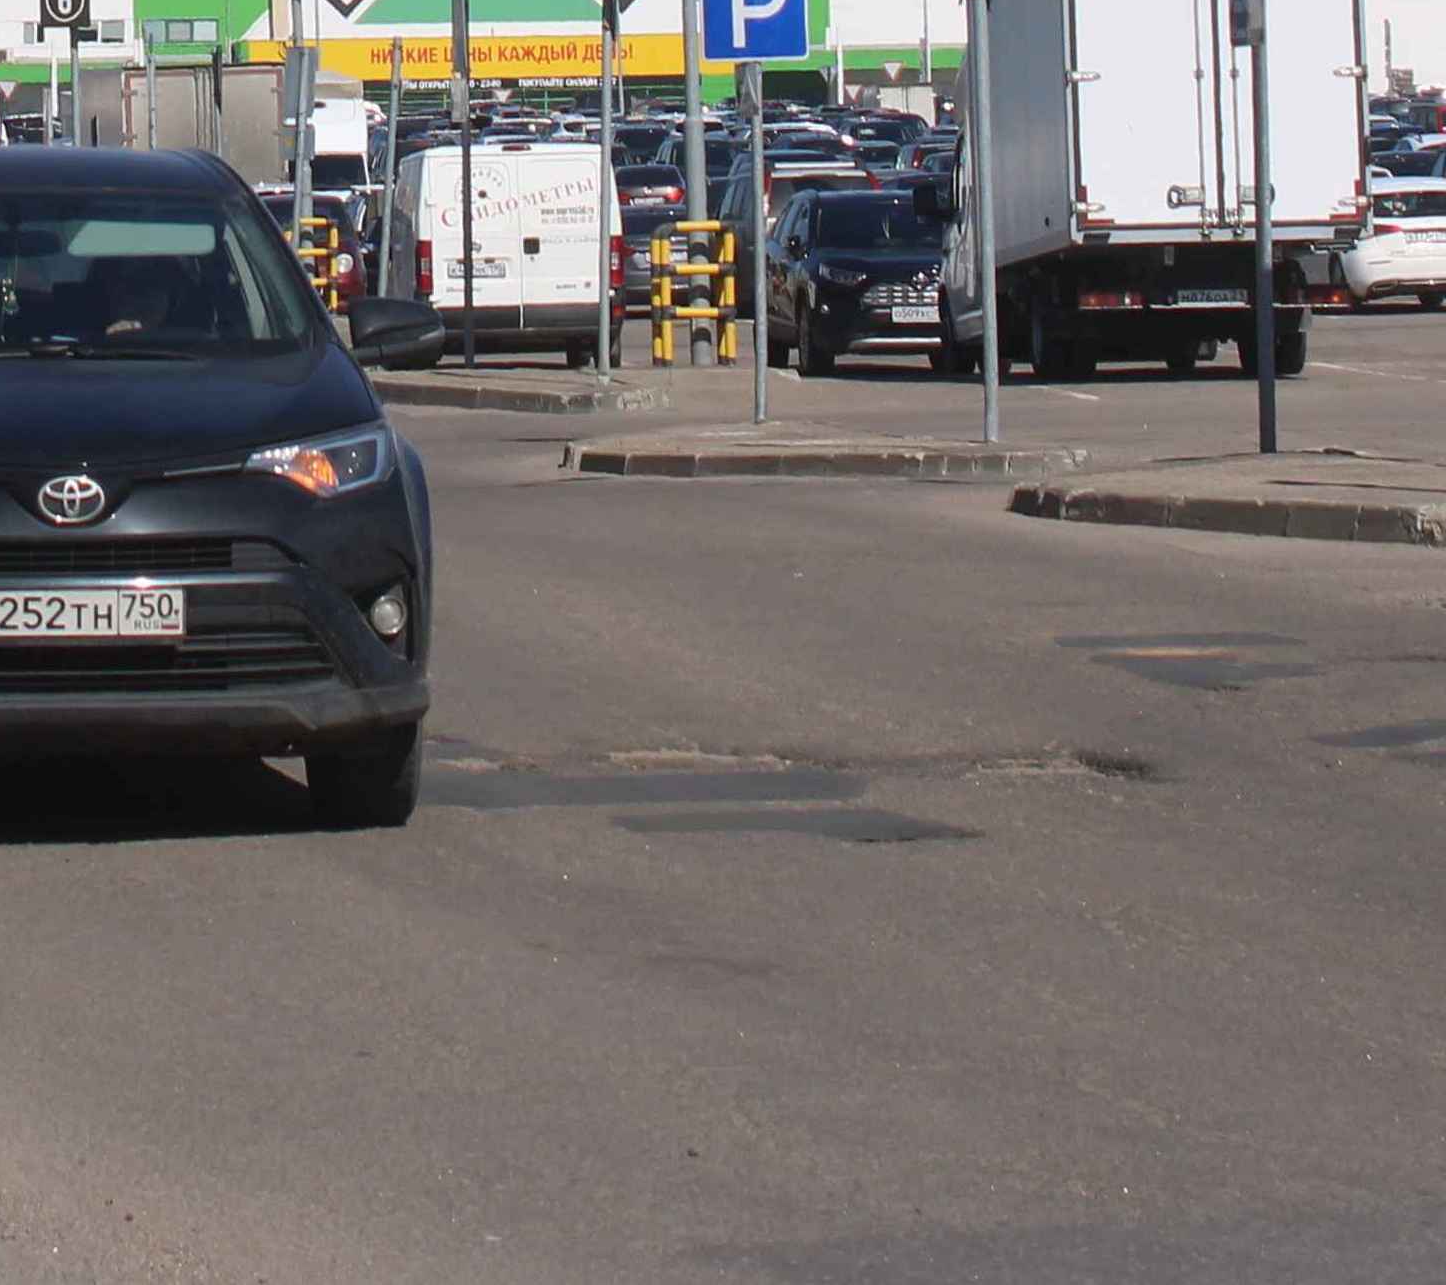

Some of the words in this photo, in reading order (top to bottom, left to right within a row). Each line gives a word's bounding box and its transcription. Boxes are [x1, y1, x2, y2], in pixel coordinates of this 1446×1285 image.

[370, 46, 438, 64] НИКИЕ
[444, 46, 493, 64] ЦНЫ
[498, 42, 577, 65] КАЖДЫЙ
[441, 177, 595, 228] СИДОМЕТРЫ
[121, 593, 174, 621] 750
[134, 619, 160, 631] RUS
